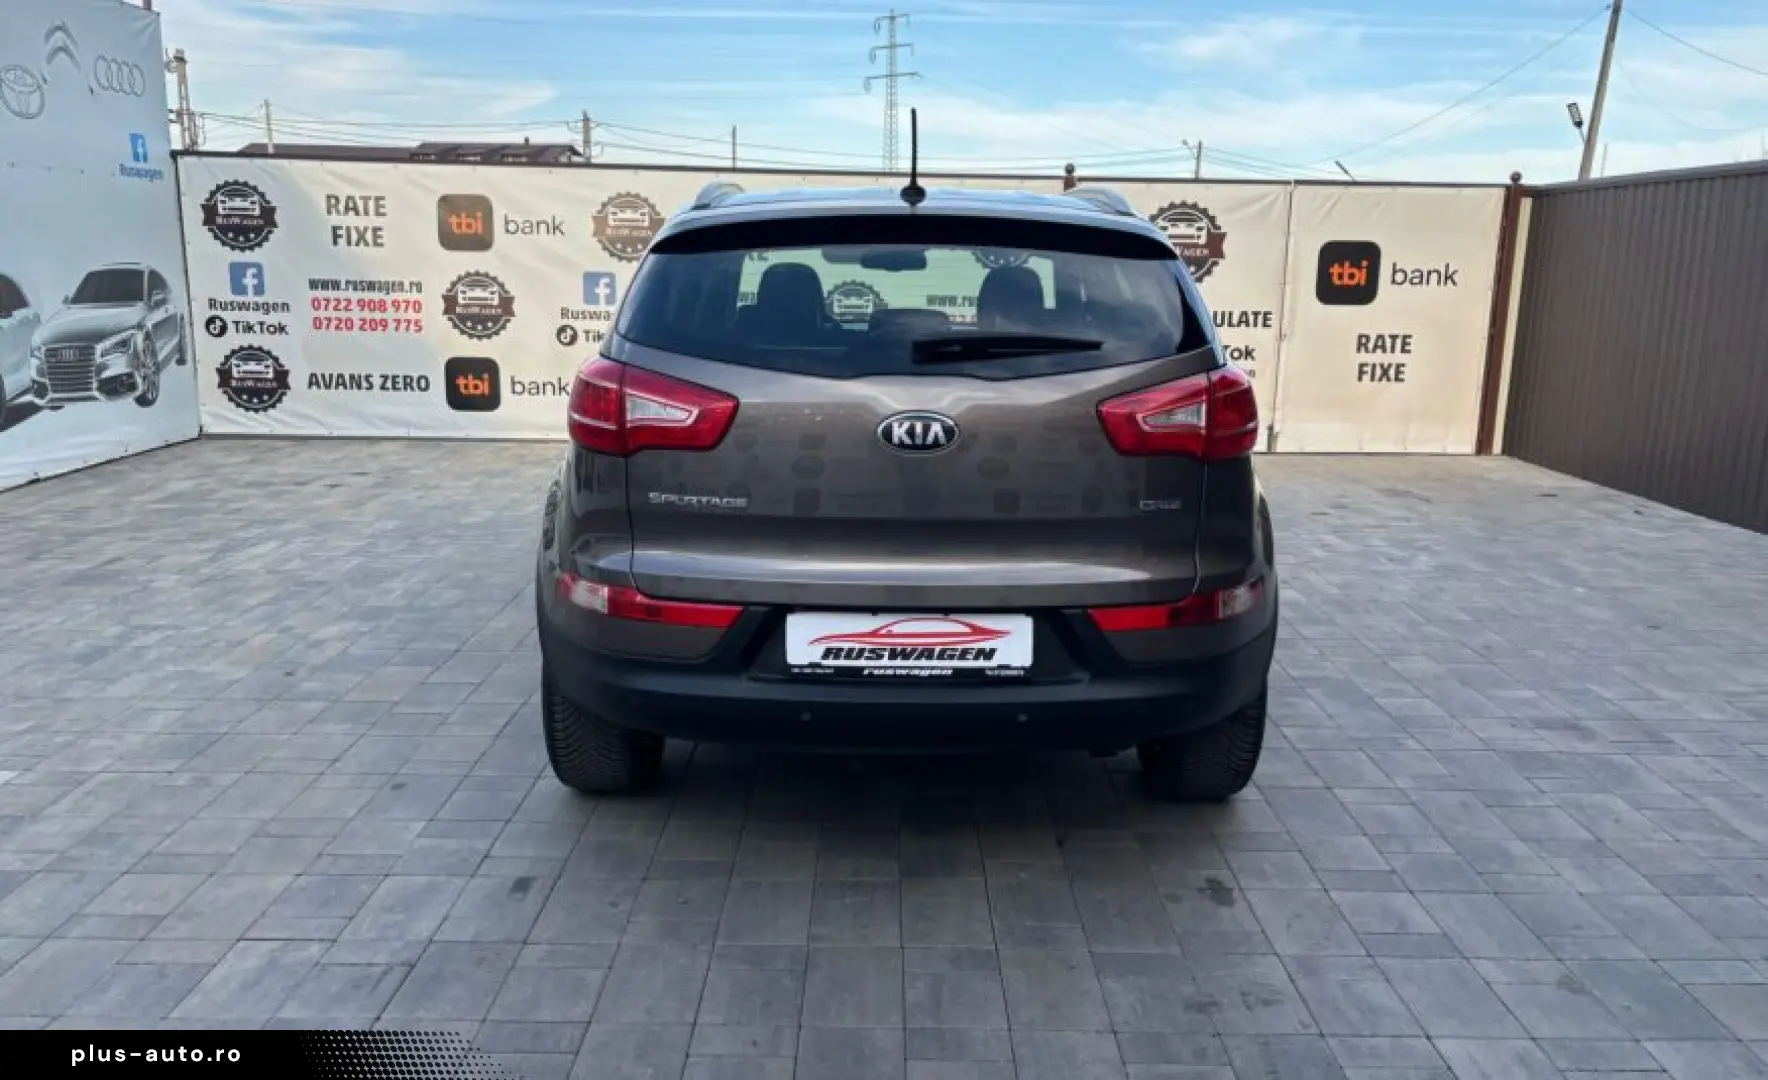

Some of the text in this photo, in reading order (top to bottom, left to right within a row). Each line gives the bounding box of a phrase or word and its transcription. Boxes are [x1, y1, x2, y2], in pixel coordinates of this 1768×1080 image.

[325, 193, 387, 217] RATE
[448, 211, 566, 237] tbi bank
[331, 225, 385, 249] FIXE
[1328, 259, 1460, 288] tbi bank
[308, 278, 423, 296] www.ruswagen.ro
[207, 298, 290, 316] Ruswagen
[311, 297, 423, 314] 0722 908 970
[560, 306, 613, 322] Ruswa
[231, 320, 290, 336] TikTok
[312, 316, 423, 334] 0720 209 775
[1212, 310, 1273, 328] ULATE
[1356, 333, 1414, 354] RATE
[1357, 362, 1406, 382] FIXE
[307, 372, 430, 392] AVANS ZERO
[456, 373, 570, 397] tbi bank
[891, 421, 947, 445] KIA
[648, 491, 748, 508] SPORTAGE
[821, 647, 998, 661] RUSWAGEN
[863, 666, 953, 677] ruswagen
